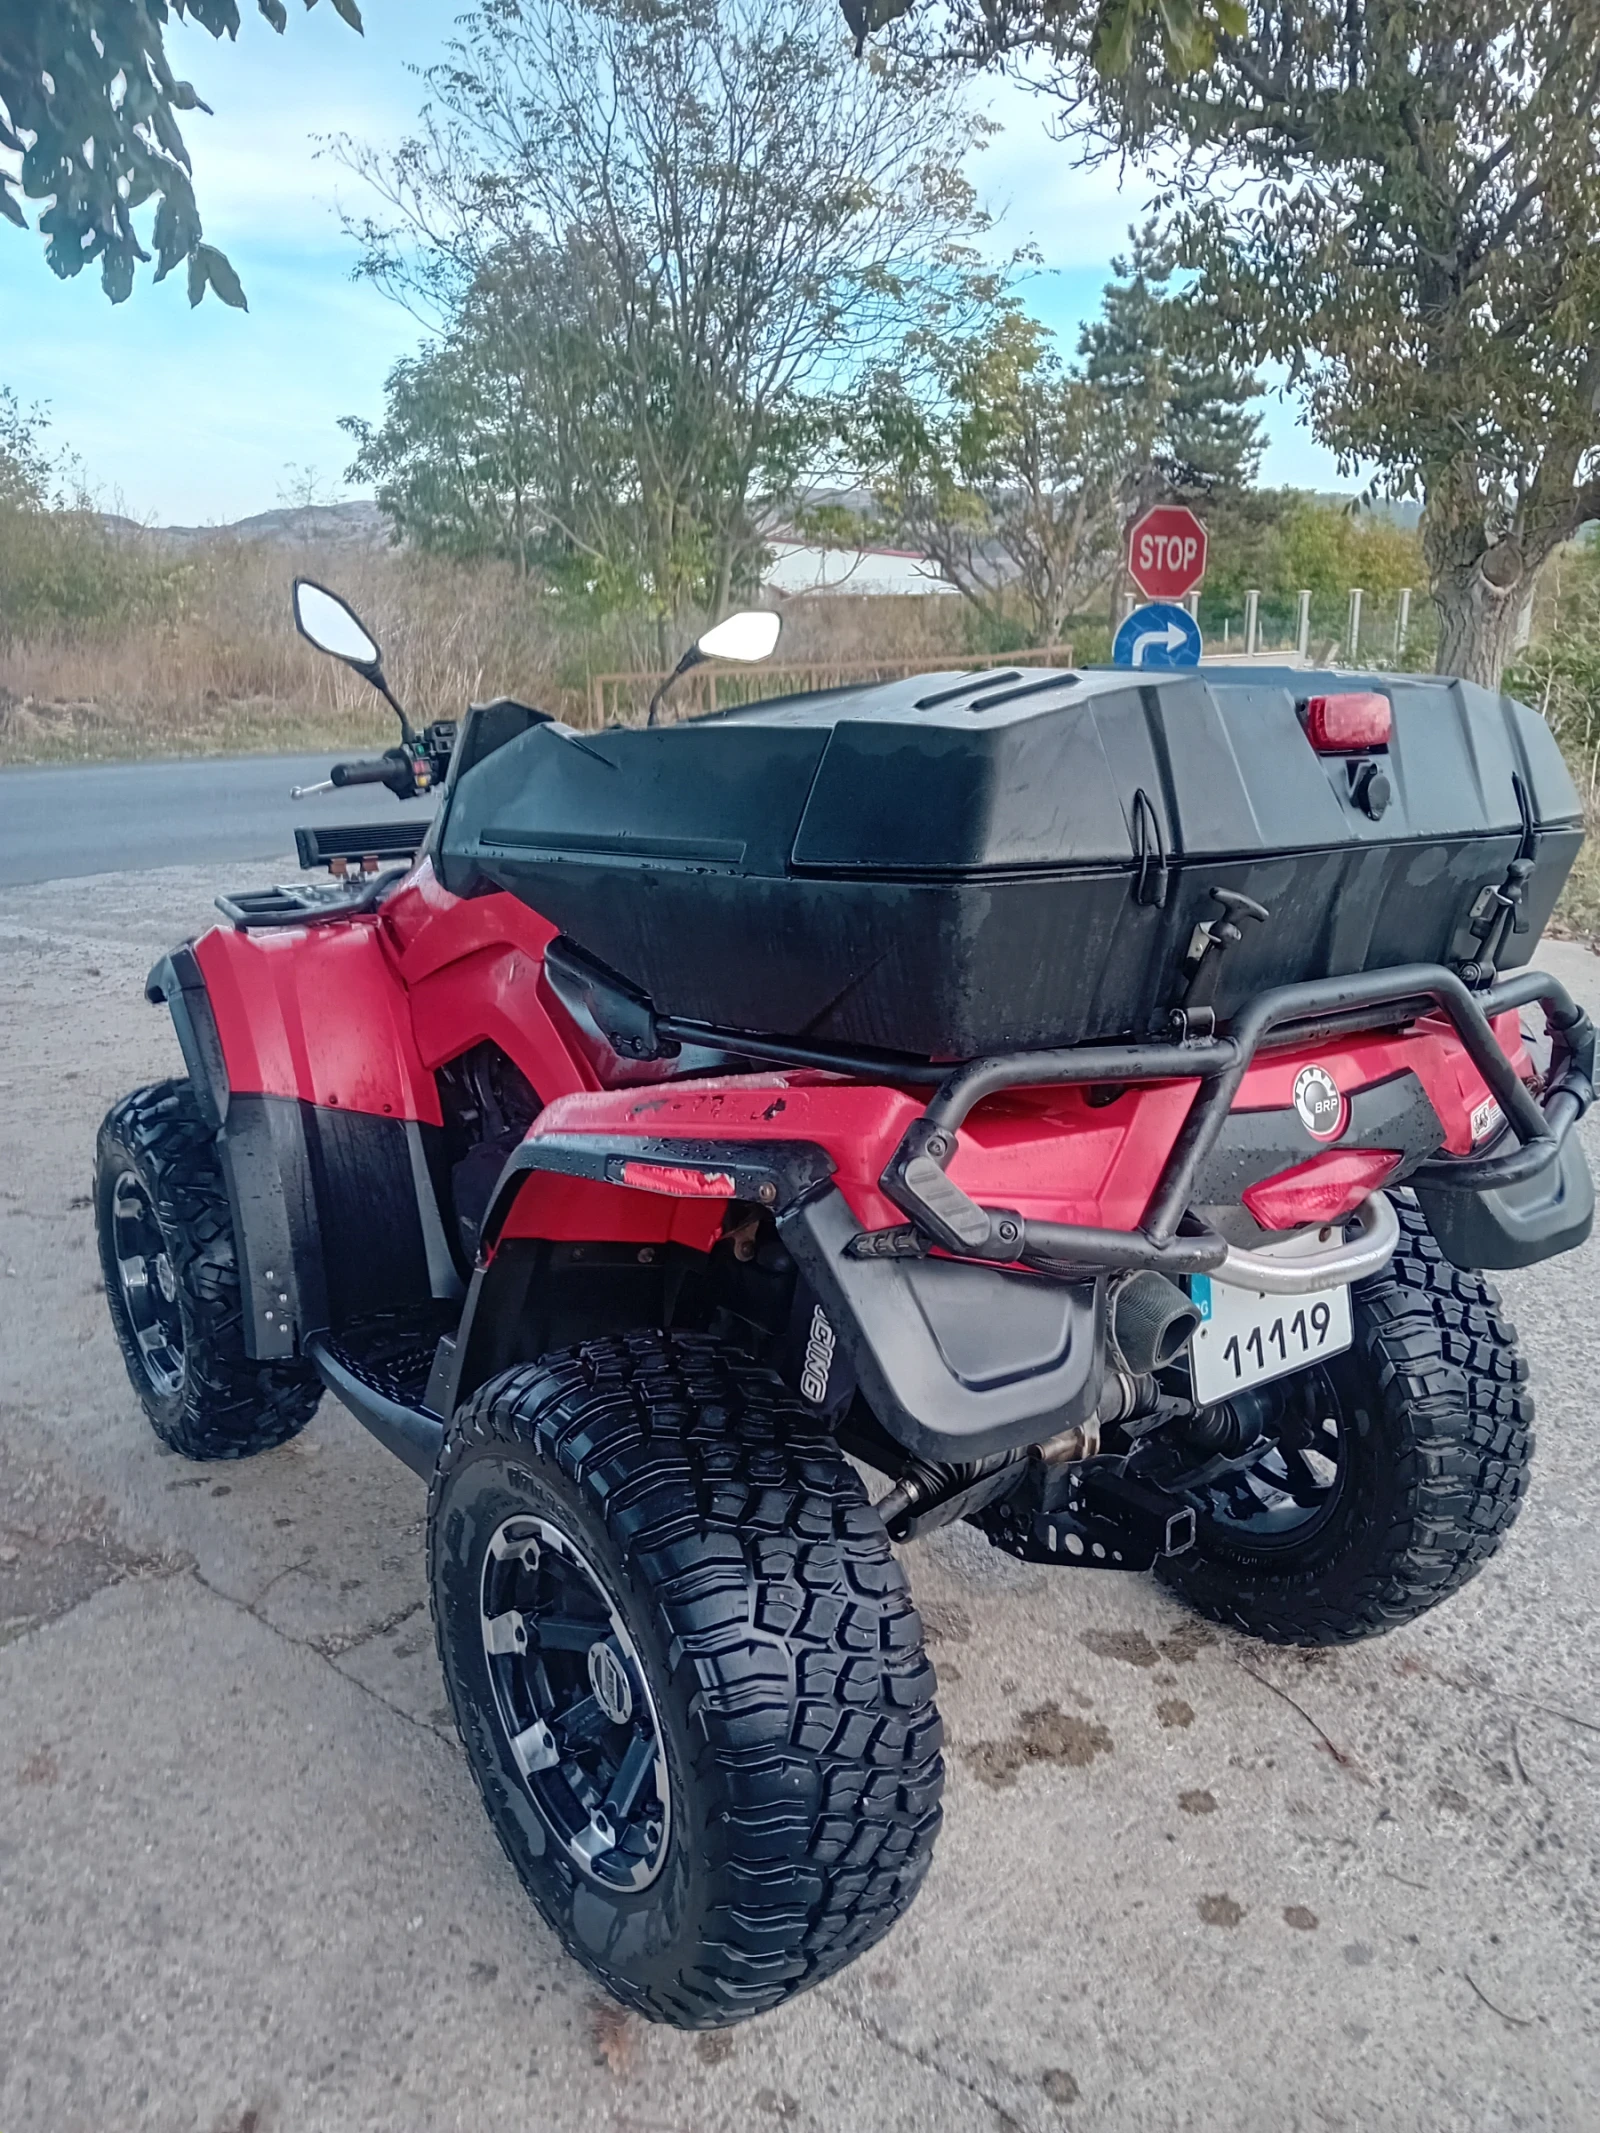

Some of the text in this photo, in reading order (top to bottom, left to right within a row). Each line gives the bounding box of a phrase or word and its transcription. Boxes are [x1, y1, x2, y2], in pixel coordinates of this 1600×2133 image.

[1139, 534, 1197, 572] STOP
[1315, 1098, 1338, 1114] BRP
[801, 1304, 836, 1402] CING
[1223, 1302, 1331, 1379] 11119
